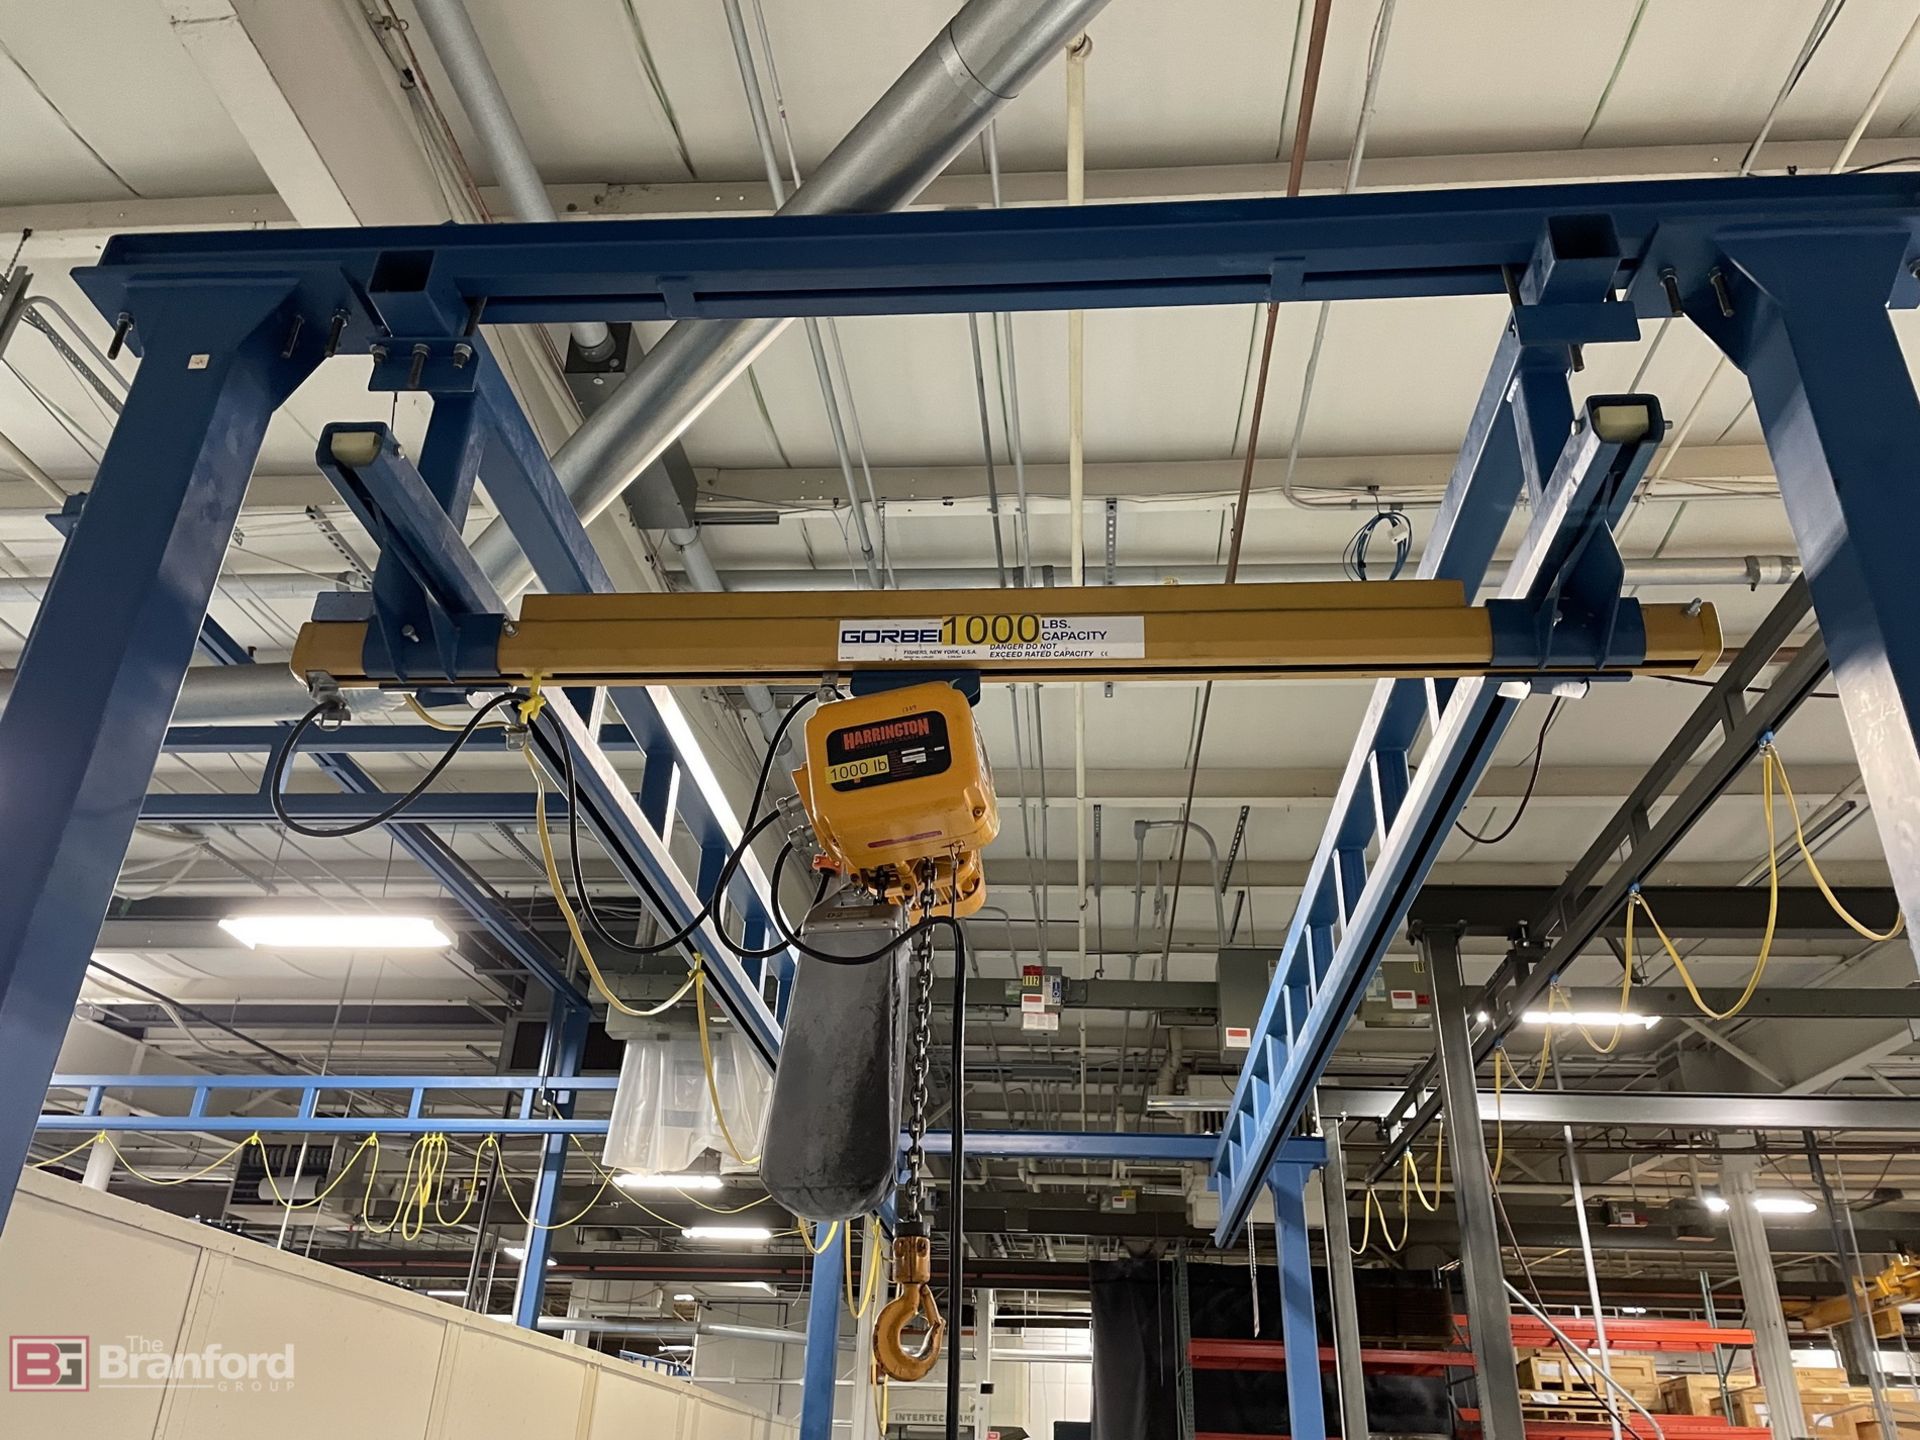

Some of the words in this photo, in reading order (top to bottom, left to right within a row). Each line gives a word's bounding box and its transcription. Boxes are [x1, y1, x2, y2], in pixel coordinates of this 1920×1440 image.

[943, 614, 1040, 645] 1000
[1041, 619, 1071, 629] LBS.
[1041, 630, 1108, 641] CAPACITY
[1039, 642, 1058, 650] NOT
[843, 718, 930, 750] HARRINGTON
[830, 761, 869, 781] 1000
[874, 759, 888, 772] lb
